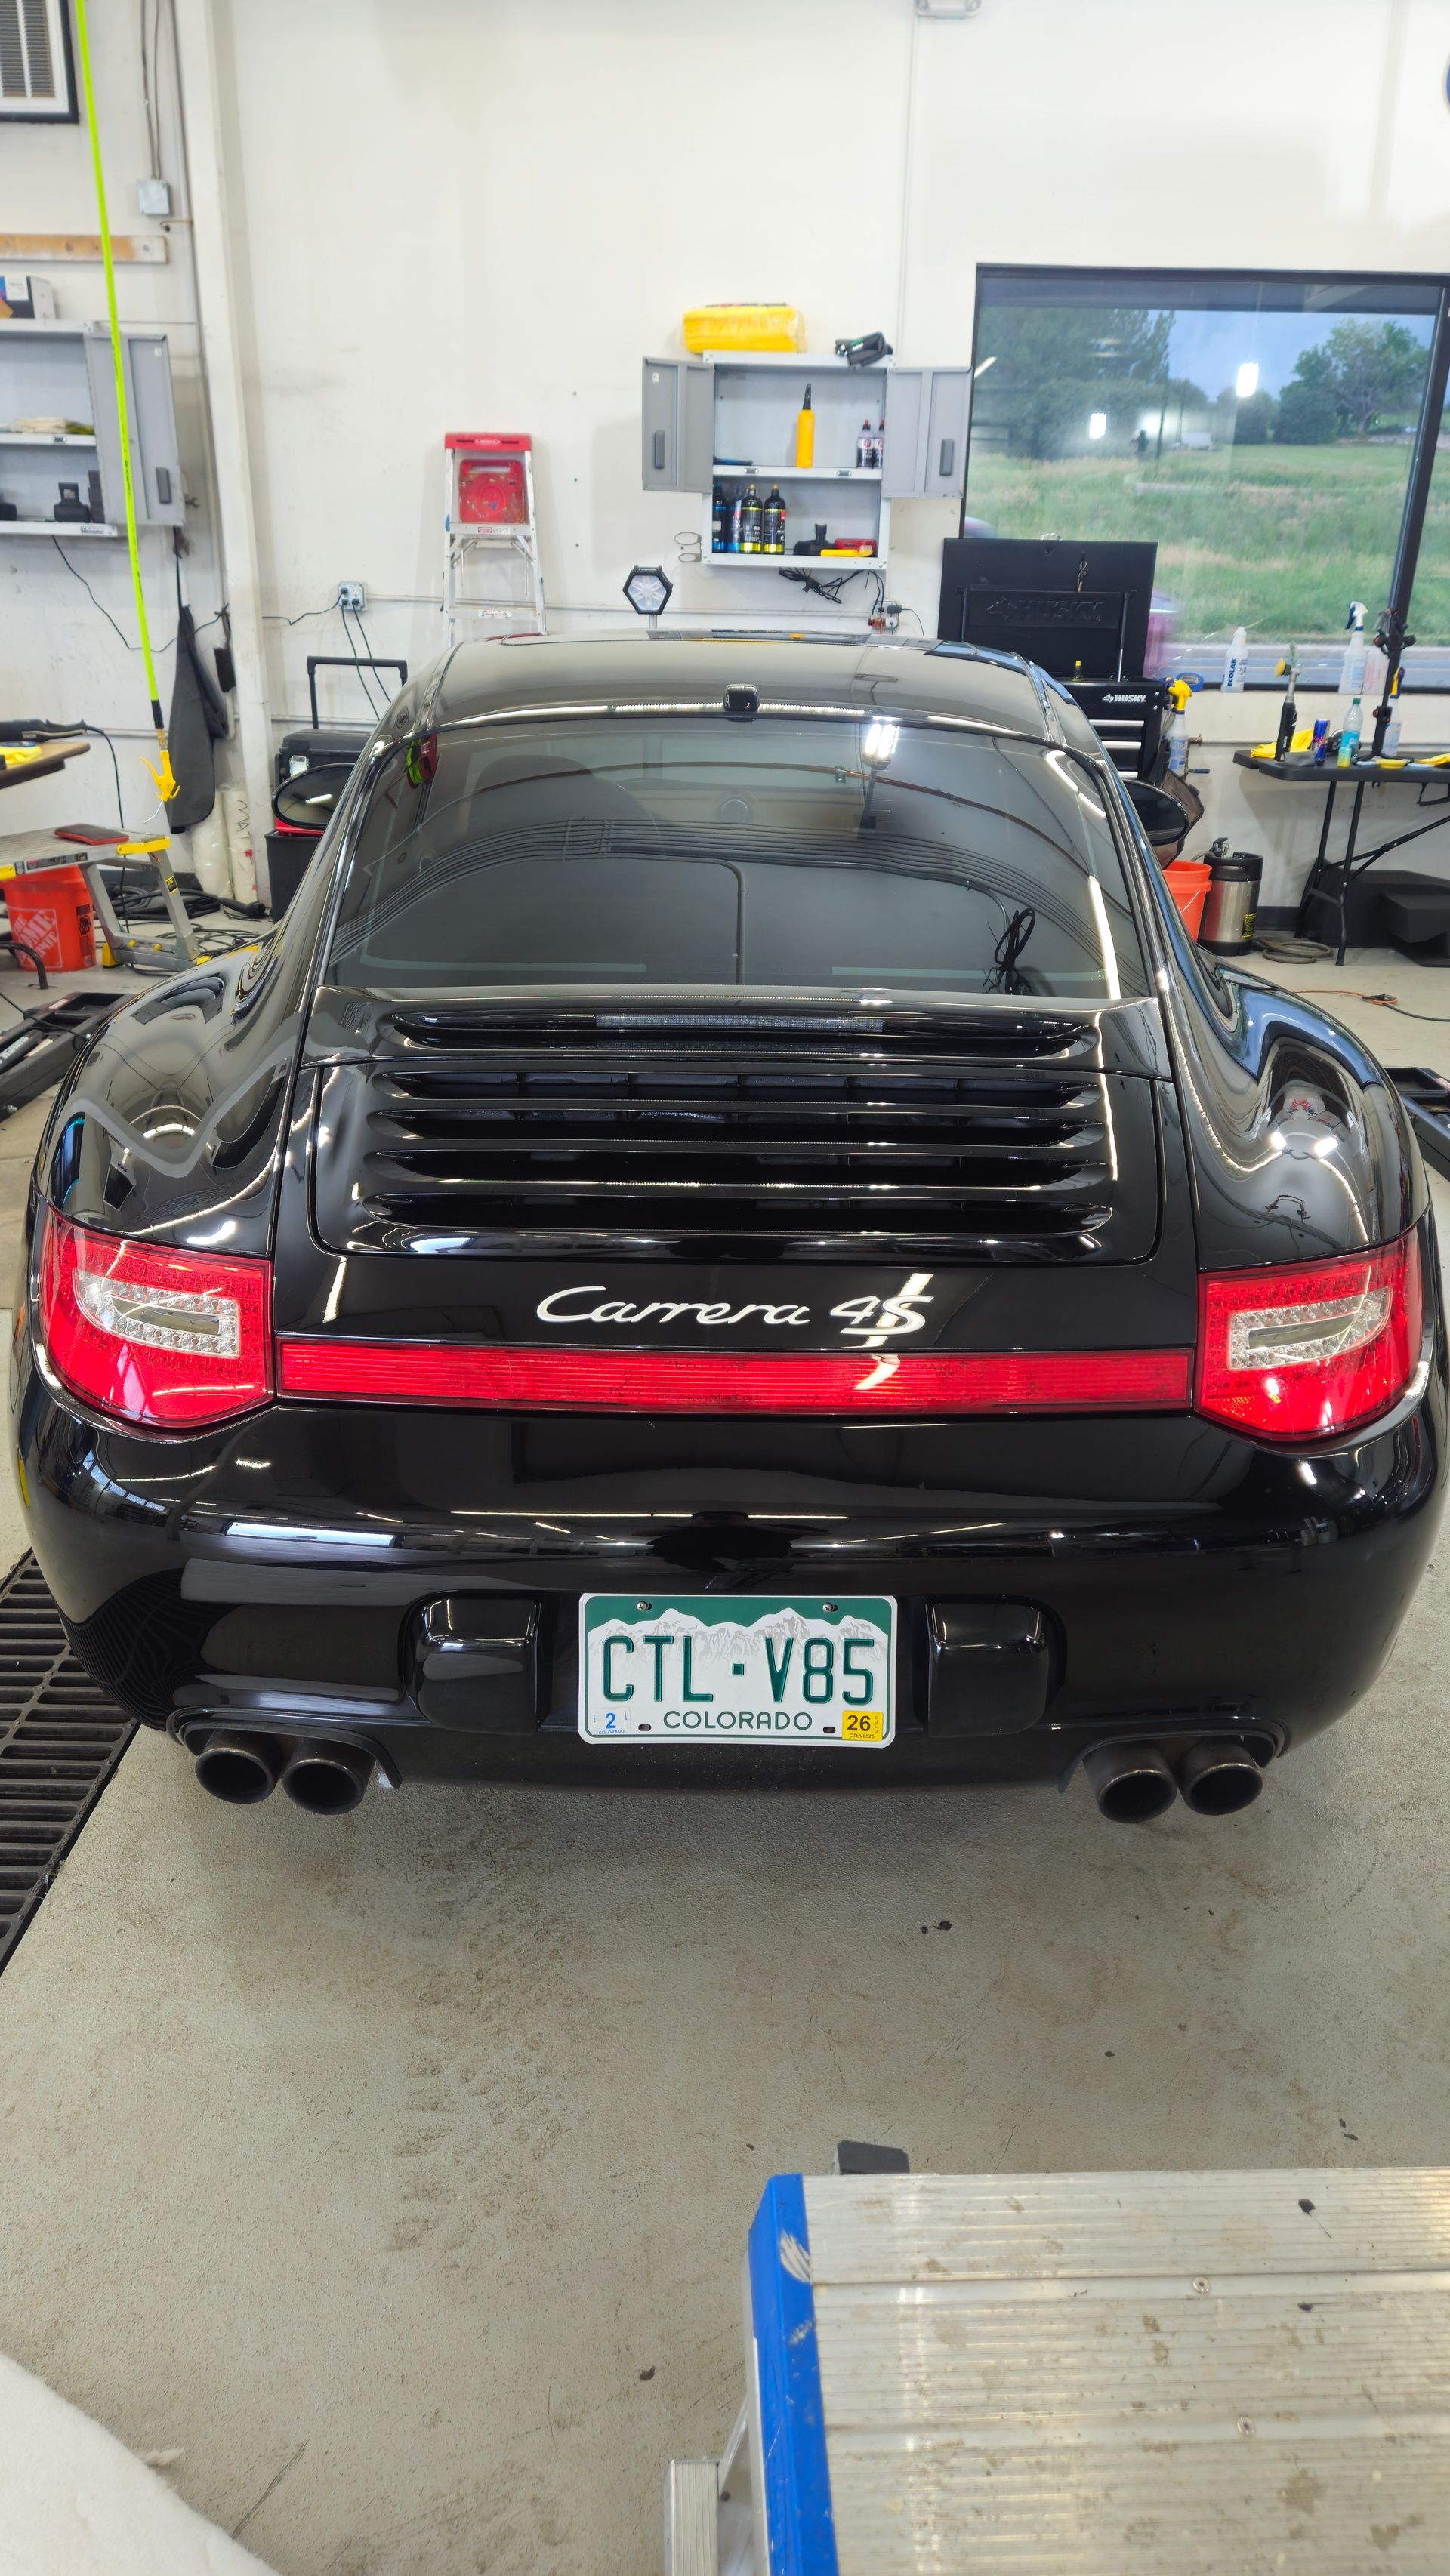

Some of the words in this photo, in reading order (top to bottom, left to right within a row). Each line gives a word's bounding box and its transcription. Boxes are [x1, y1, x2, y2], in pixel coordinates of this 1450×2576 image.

[1227, 658, 1237, 687] ECOLAB
[1114, 694, 1147, 703] HUSKY
[535, 1285, 810, 1326] Carrera
[829, 1295, 936, 1336] 4S
[606, 1712, 616, 1729] 2
[663, 1710, 813, 1730] COLORADO
[847, 1715, 871, 1732] 26
